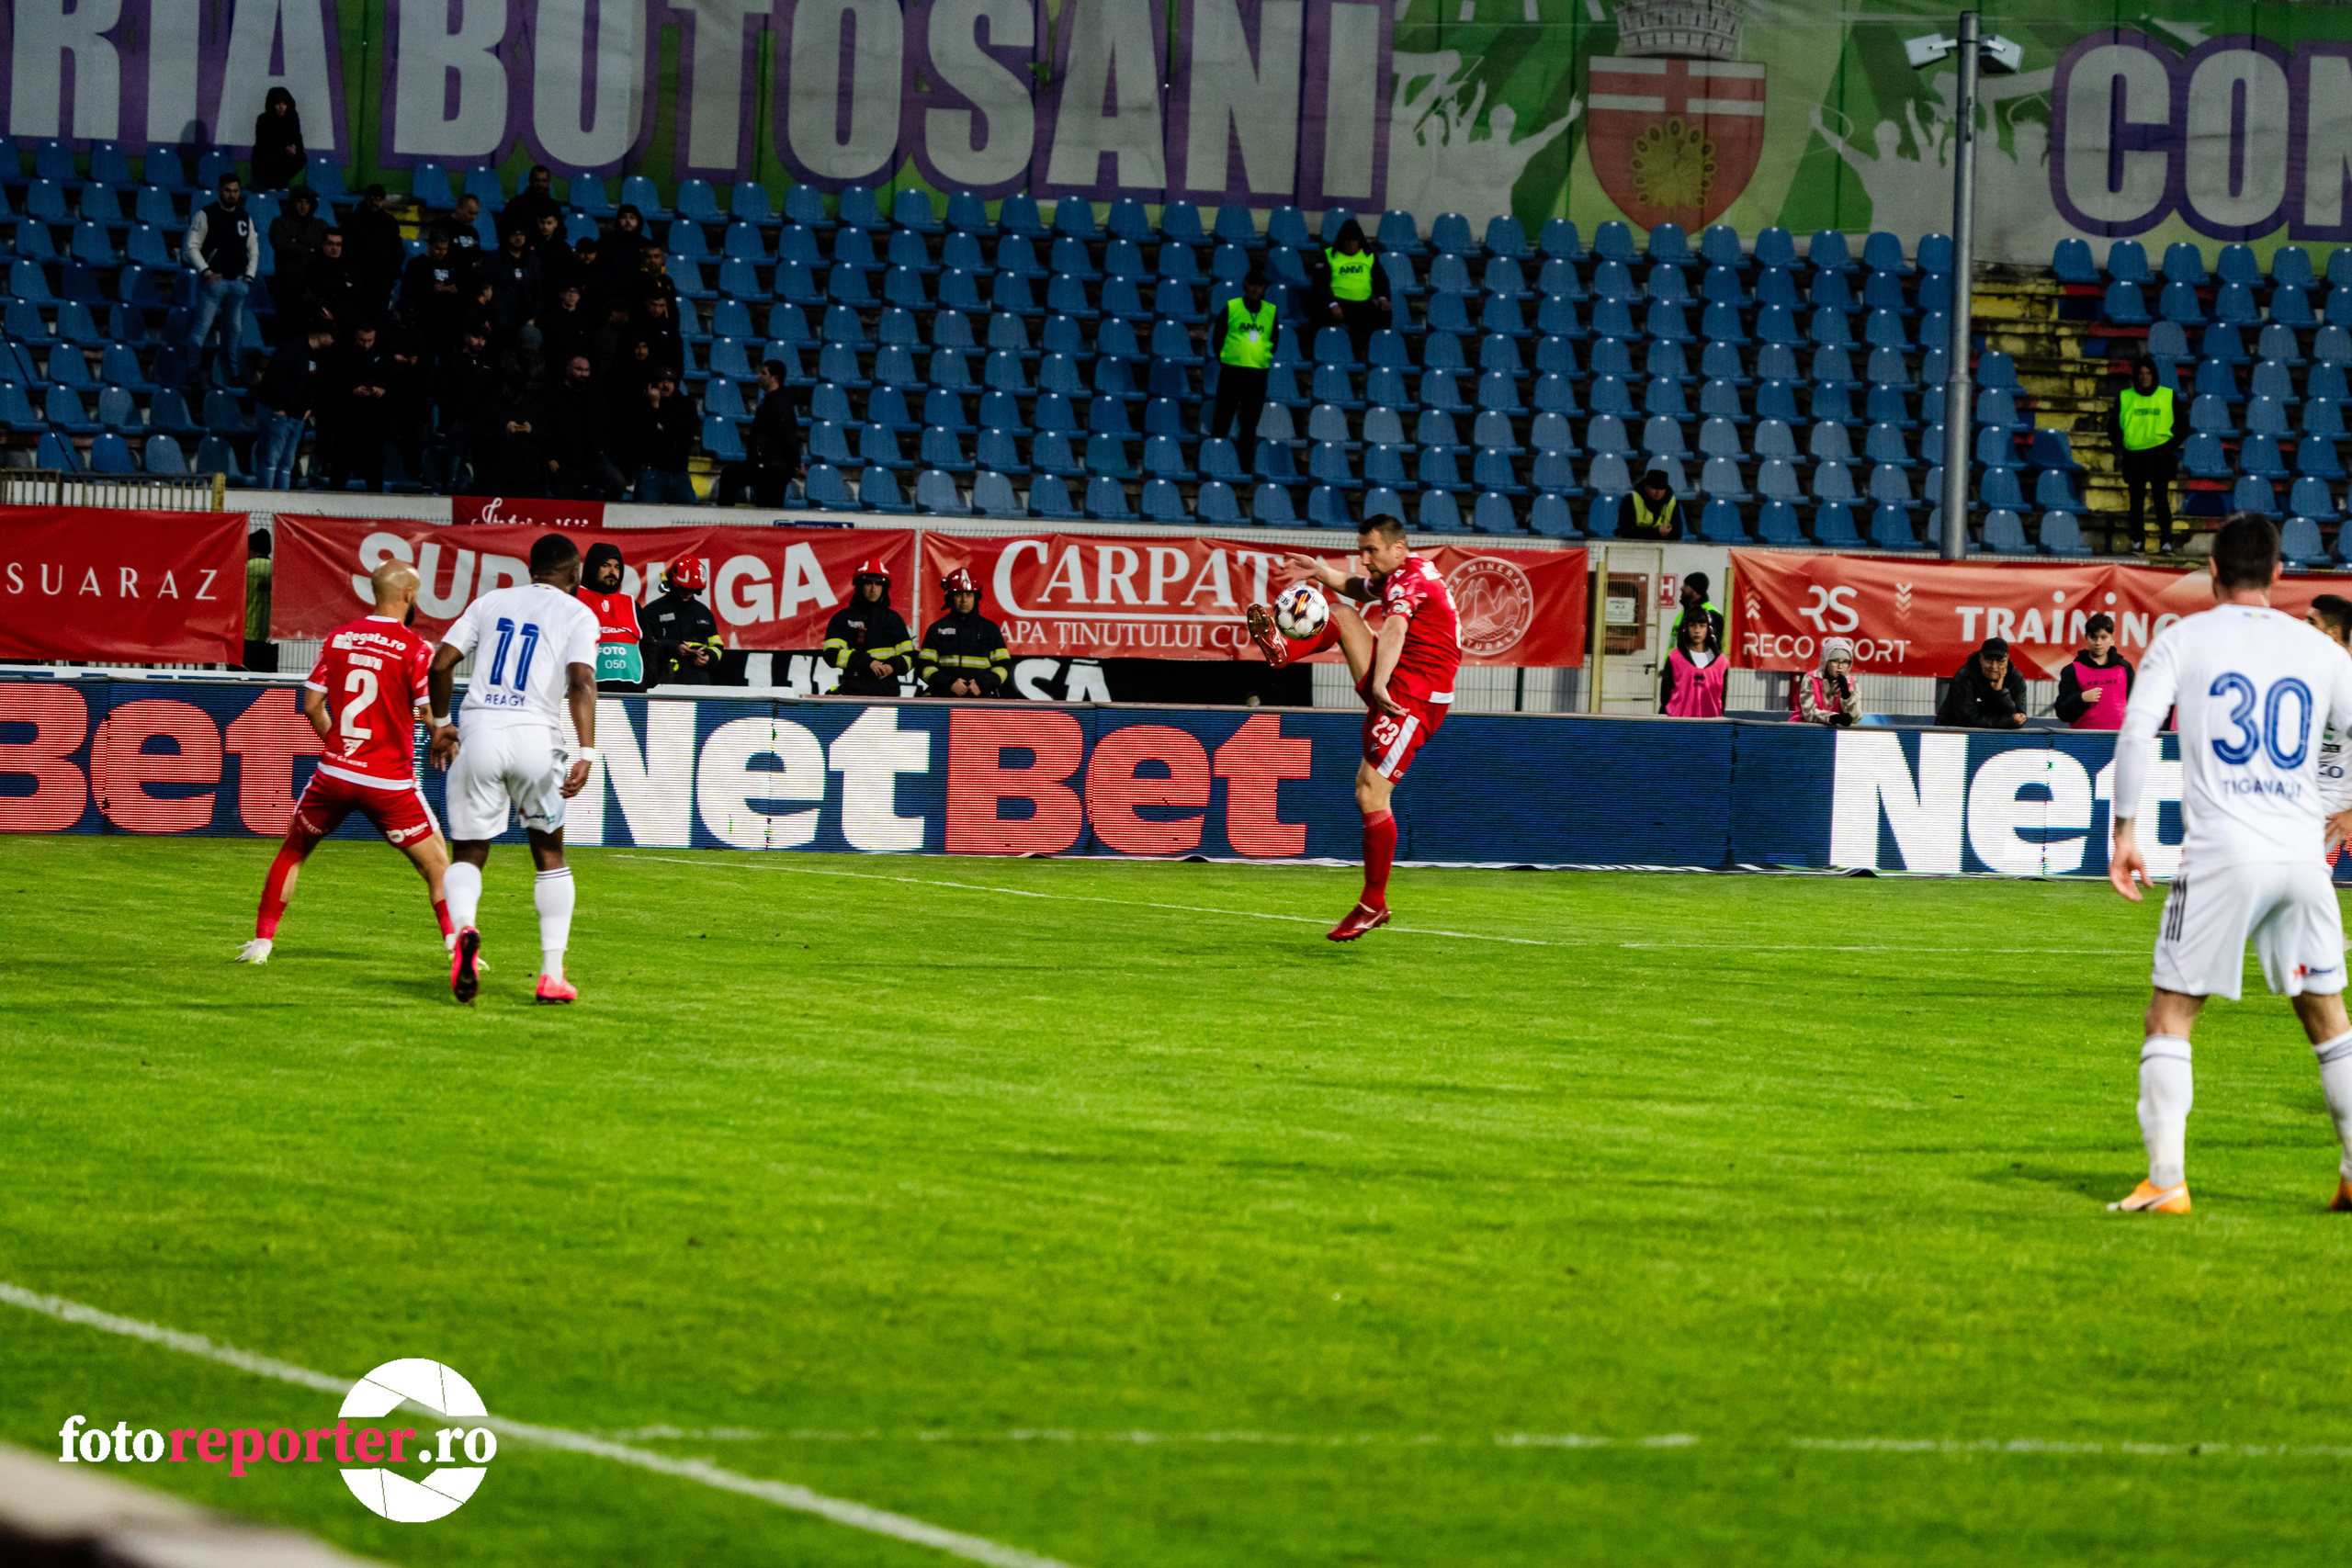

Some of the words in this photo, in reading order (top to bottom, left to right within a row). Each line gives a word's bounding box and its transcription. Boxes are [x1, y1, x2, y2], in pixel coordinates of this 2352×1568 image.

[6, 562, 218, 601] SUARAZ
[1798, 584, 1860, 633] RS
[489, 616, 540, 692] 11
[605, 659, 628, 670] 050
[1743, 632, 1815, 659] RECO
[339, 668, 379, 740] 2
[2209, 671, 2313, 770] 30
[1371, 715, 1400, 746] 23
